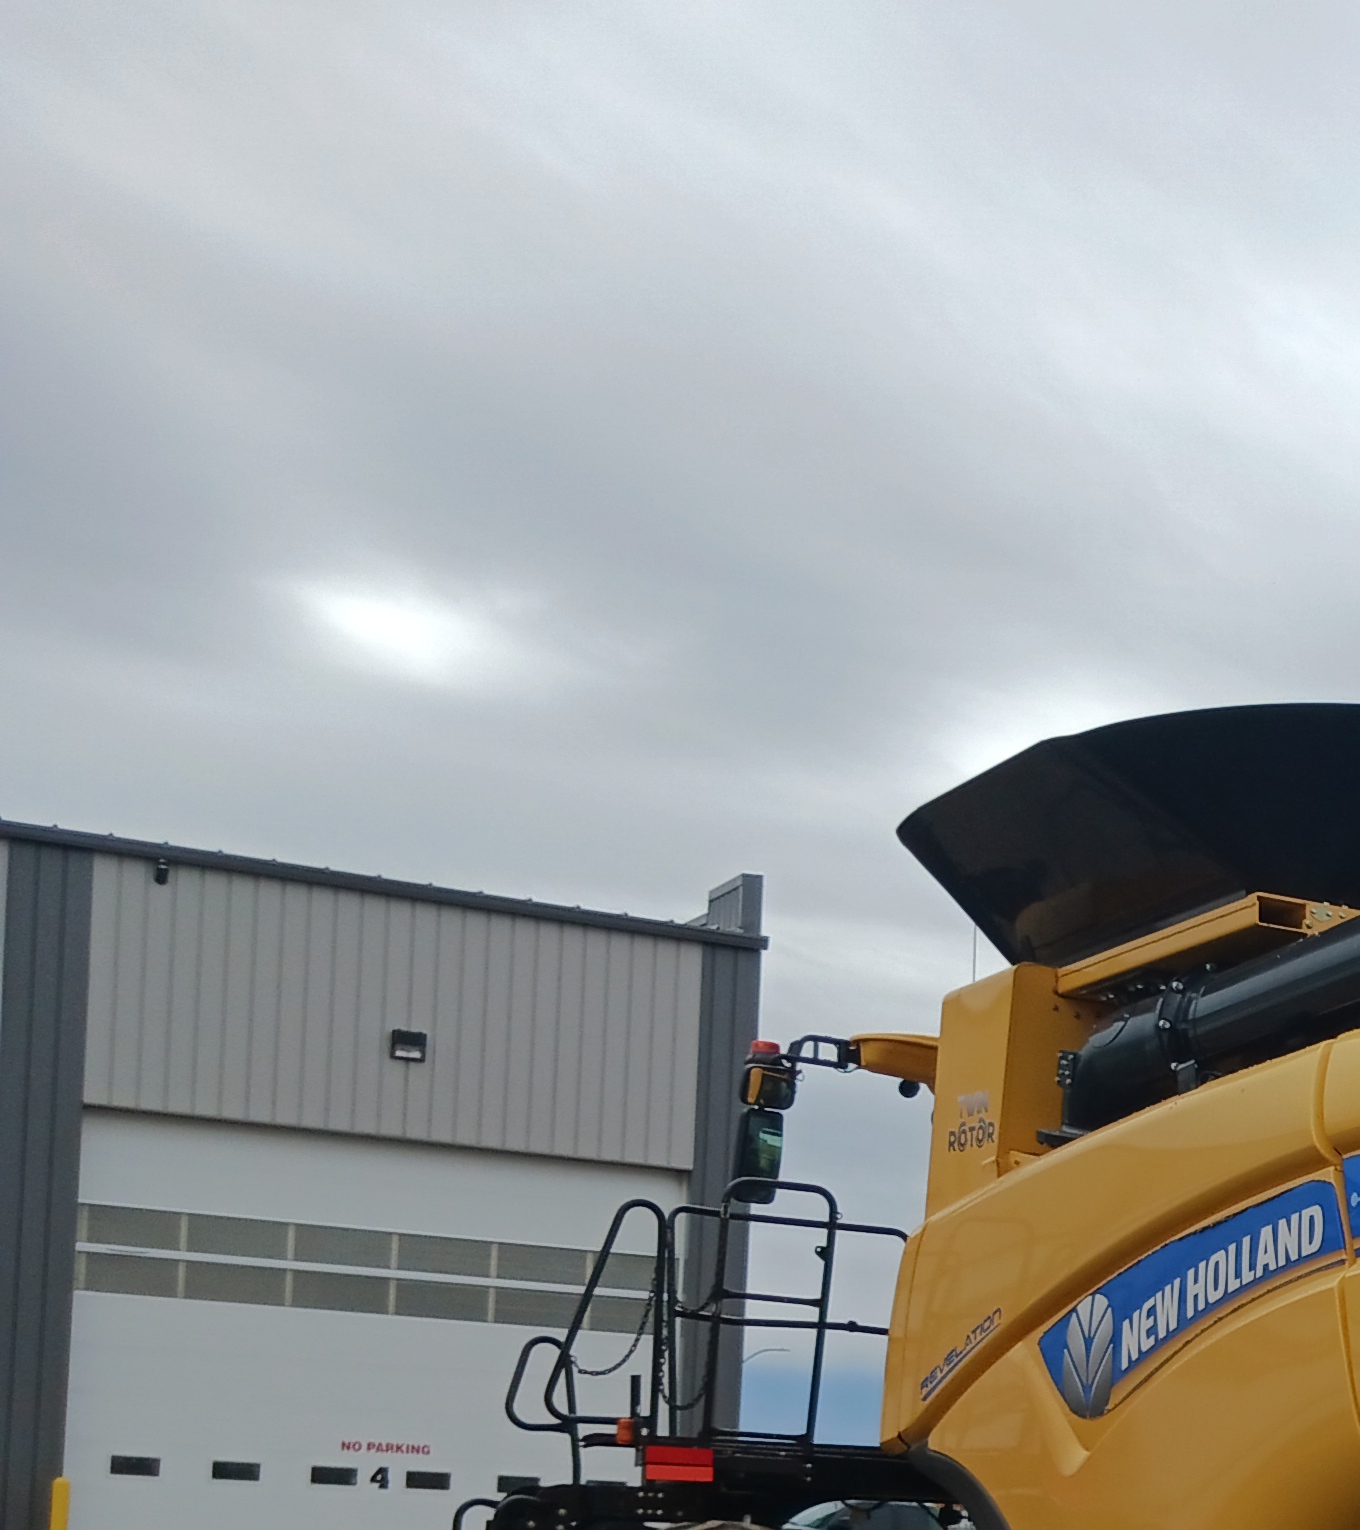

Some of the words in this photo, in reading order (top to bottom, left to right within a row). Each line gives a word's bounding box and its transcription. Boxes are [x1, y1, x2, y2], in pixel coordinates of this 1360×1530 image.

[948, 1116, 995, 1152] ROTOR
[1121, 1277, 1181, 1371] NEW
[1186, 1204, 1324, 1320] HOLLAND
[341, 1441, 363, 1452] NO
[366, 1441, 431, 1455] PARKING
[370, 1467, 389, 1489] 4
